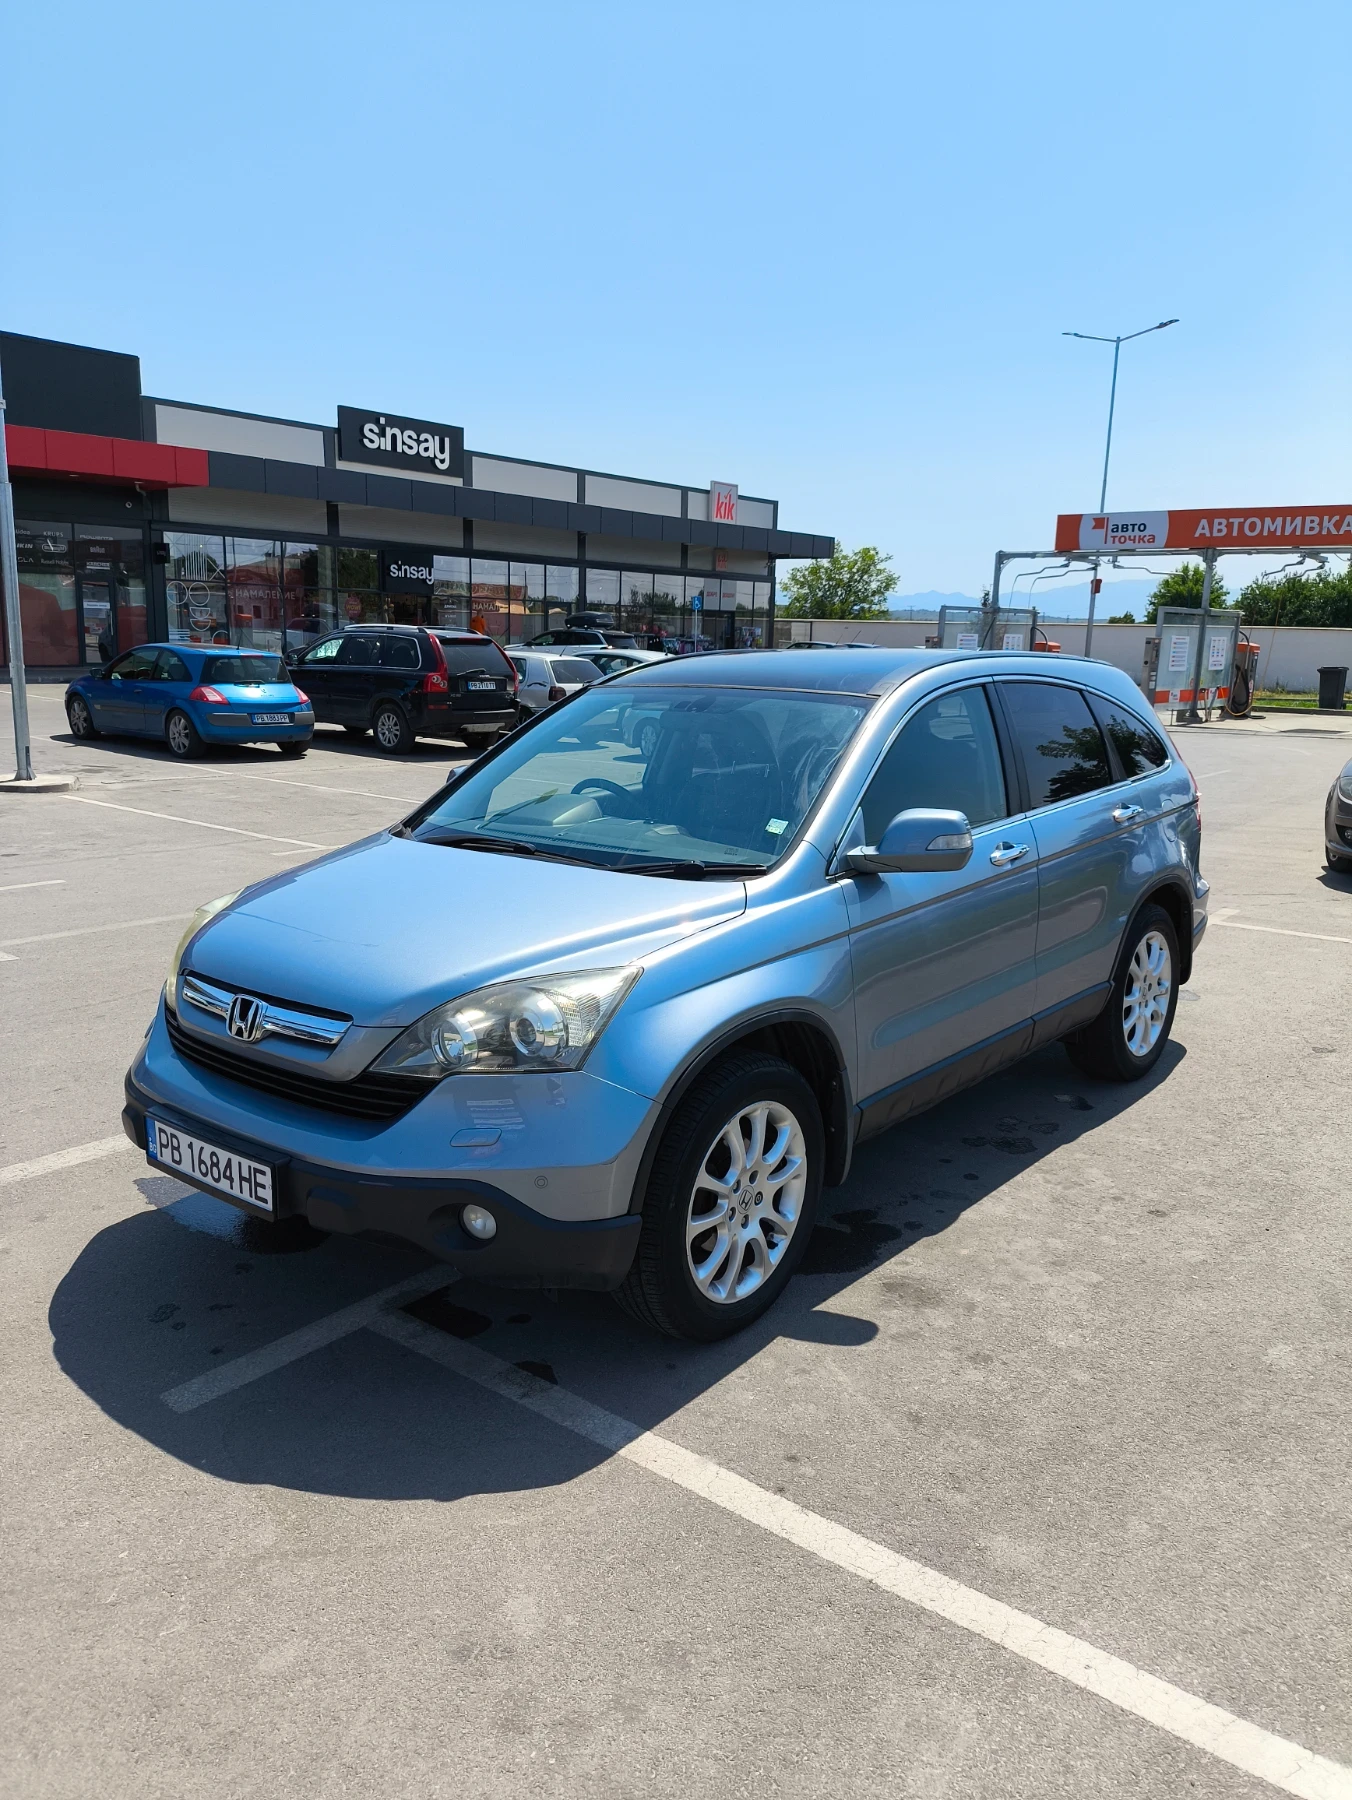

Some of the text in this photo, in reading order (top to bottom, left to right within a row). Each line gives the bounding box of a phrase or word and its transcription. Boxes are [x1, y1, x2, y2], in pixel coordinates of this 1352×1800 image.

[363, 416, 450, 470] sinsay
[715, 488, 735, 520] kik
[1110, 521, 1147, 533] авто
[1193, 514, 1352, 538] АВТОМИВКА
[1110, 533, 1156, 545] точка
[389, 560, 434, 584] sinsay
